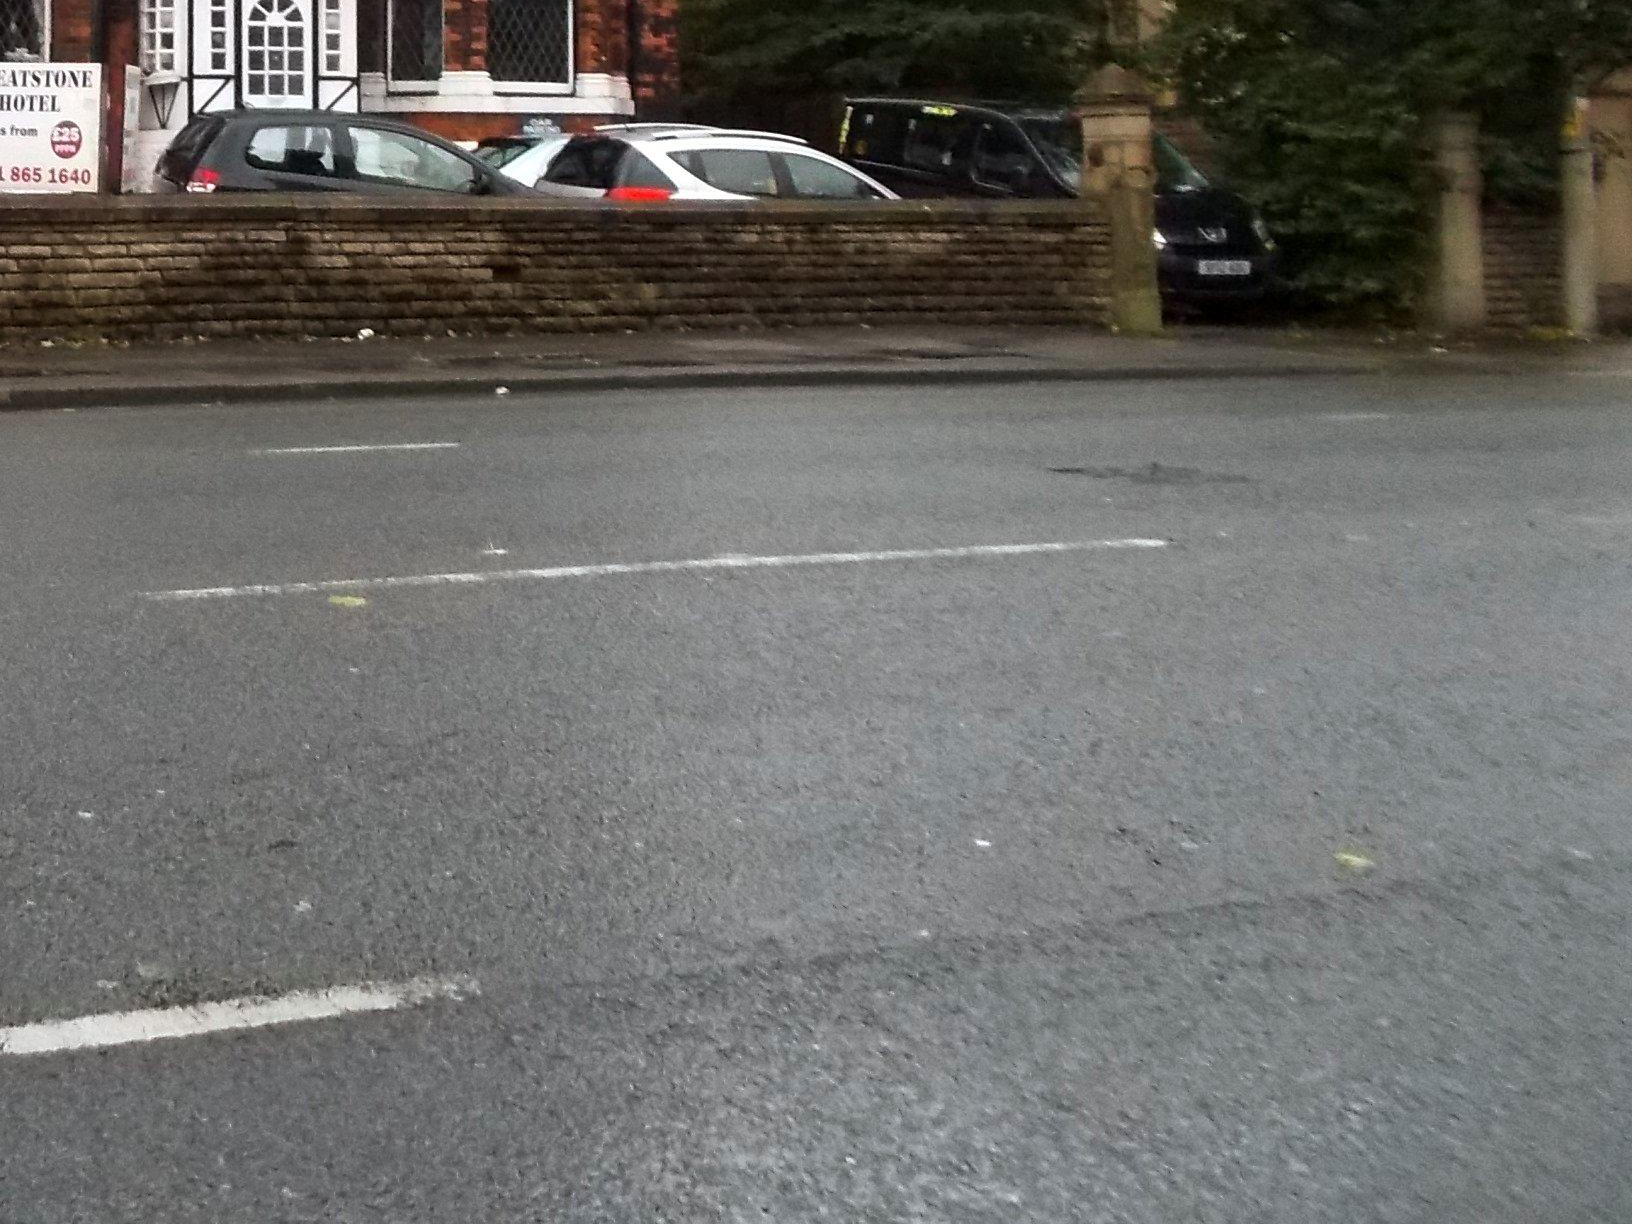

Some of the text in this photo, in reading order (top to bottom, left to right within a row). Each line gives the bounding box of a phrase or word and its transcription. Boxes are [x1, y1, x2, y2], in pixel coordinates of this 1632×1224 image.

[0, 94, 60, 112] HOTEL
[10, 124, 38, 137] from
[10, 167, 42, 182] 865
[49, 169, 91, 185] 1640
